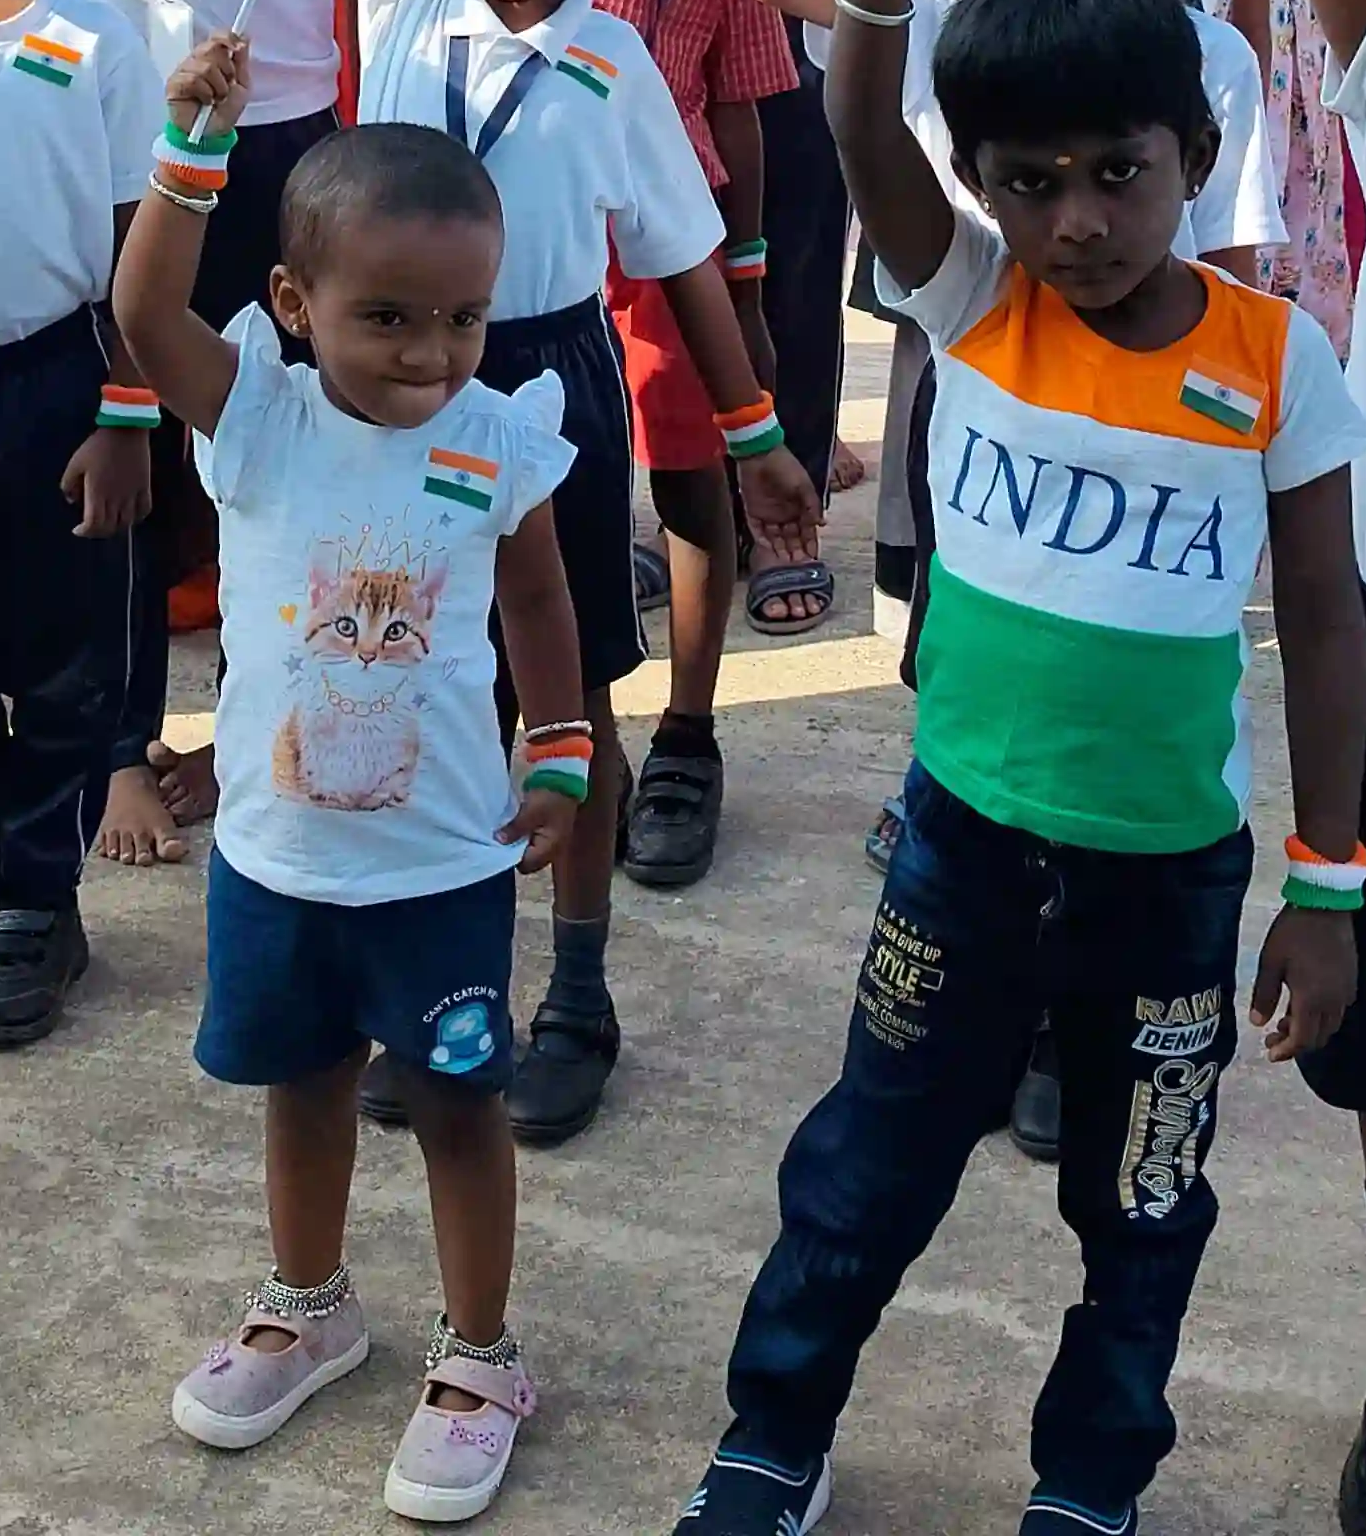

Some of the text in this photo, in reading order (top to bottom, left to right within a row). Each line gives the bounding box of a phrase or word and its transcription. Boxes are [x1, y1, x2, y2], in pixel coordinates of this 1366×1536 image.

[946, 425, 1225, 581] INDIA
[897, 933, 924, 958] GIVE
[923, 944, 942, 963] UP
[875, 945, 922, 992] STYLE
[453, 985, 487, 1002] CATCH
[1135, 983, 1221, 1026] RAW
[880, 1009, 930, 1038] COMPANY
[1139, 1021, 1215, 1052] DENIM
